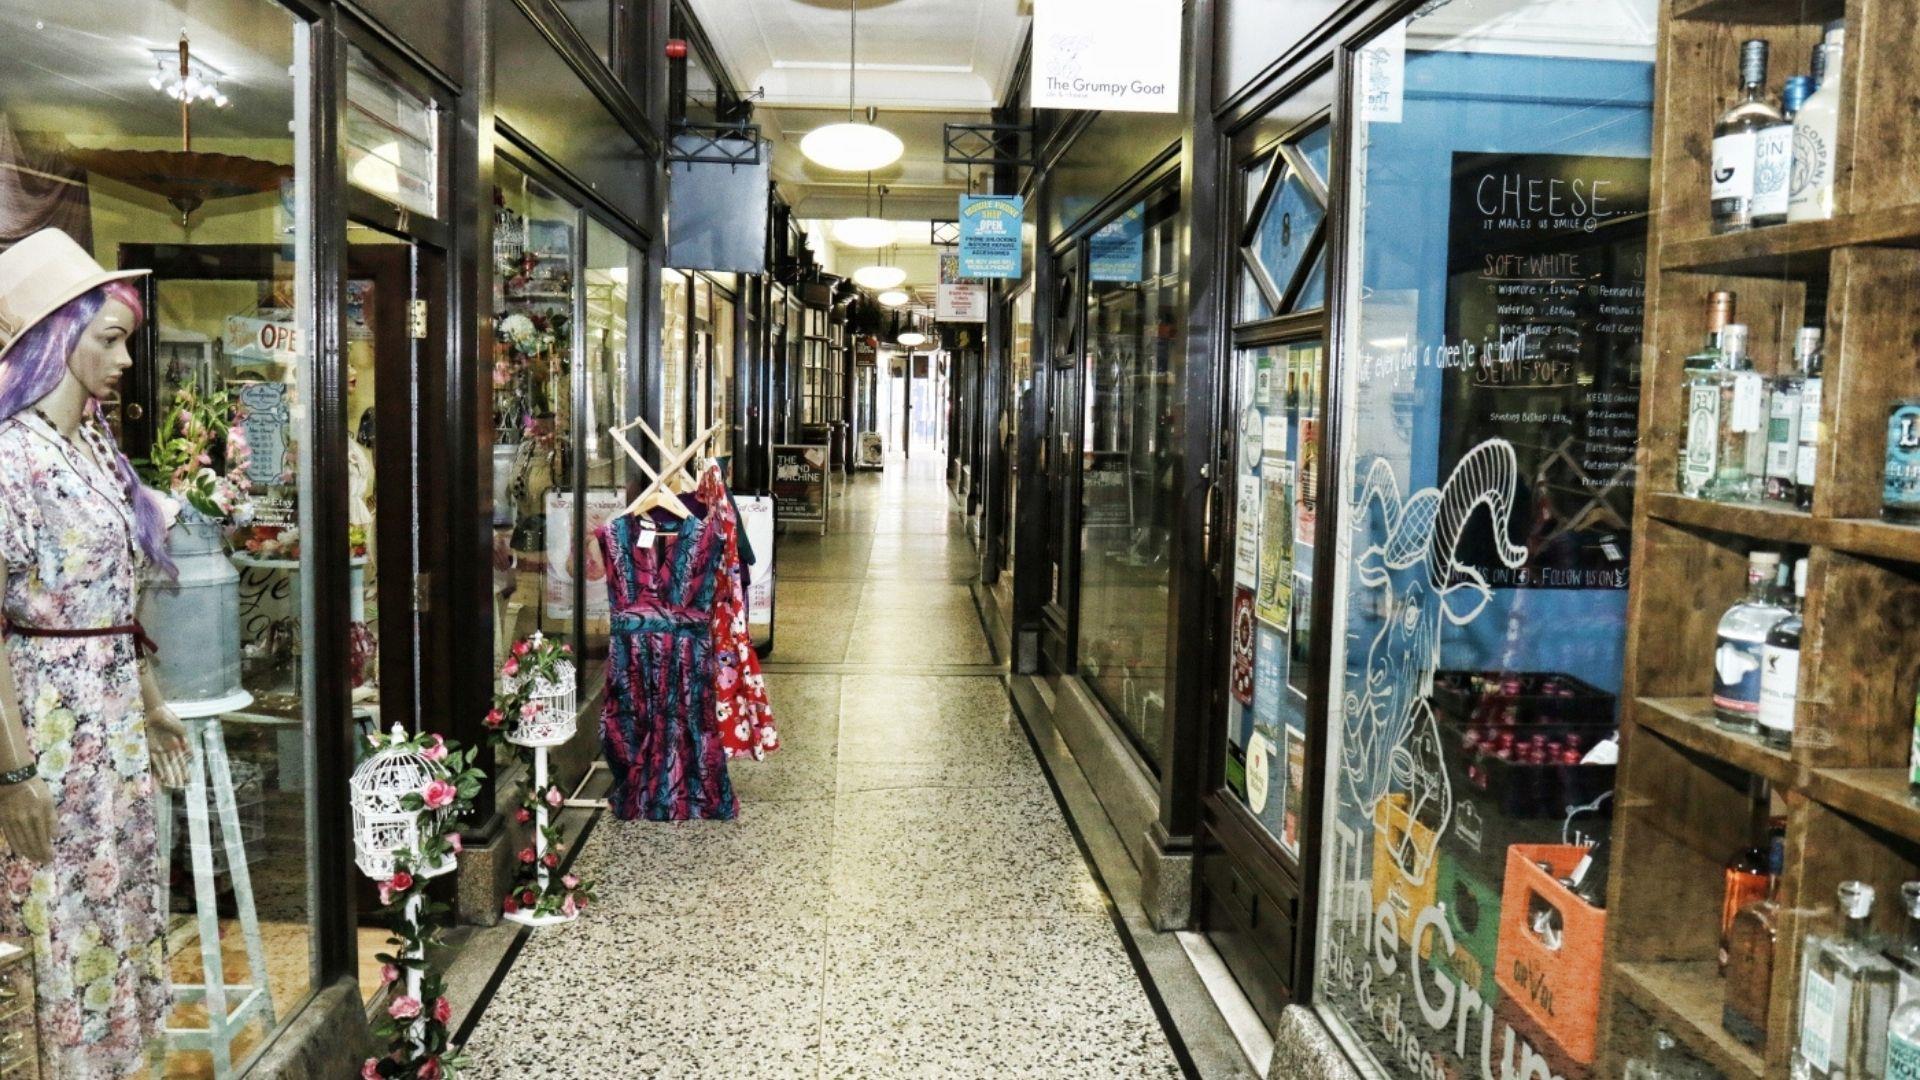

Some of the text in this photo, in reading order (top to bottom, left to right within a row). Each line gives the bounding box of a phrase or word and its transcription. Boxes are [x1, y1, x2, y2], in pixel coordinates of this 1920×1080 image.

[1047, 77, 1165, 96] The Grumpy Goat
[1756, 141, 1784, 158] GIN
[980, 219, 1003, 231] OPEN
[1483, 219, 1580, 230] IT MAKES US SMILE
[1423, 345, 1431, 367] a
[1436, 334, 1475, 372] cheese
[1483, 336, 1493, 367] is
[777, 455, 797, 465] THE
[1542, 567, 1583, 585] FOLLOW
[1335, 821, 1399, 975] The
